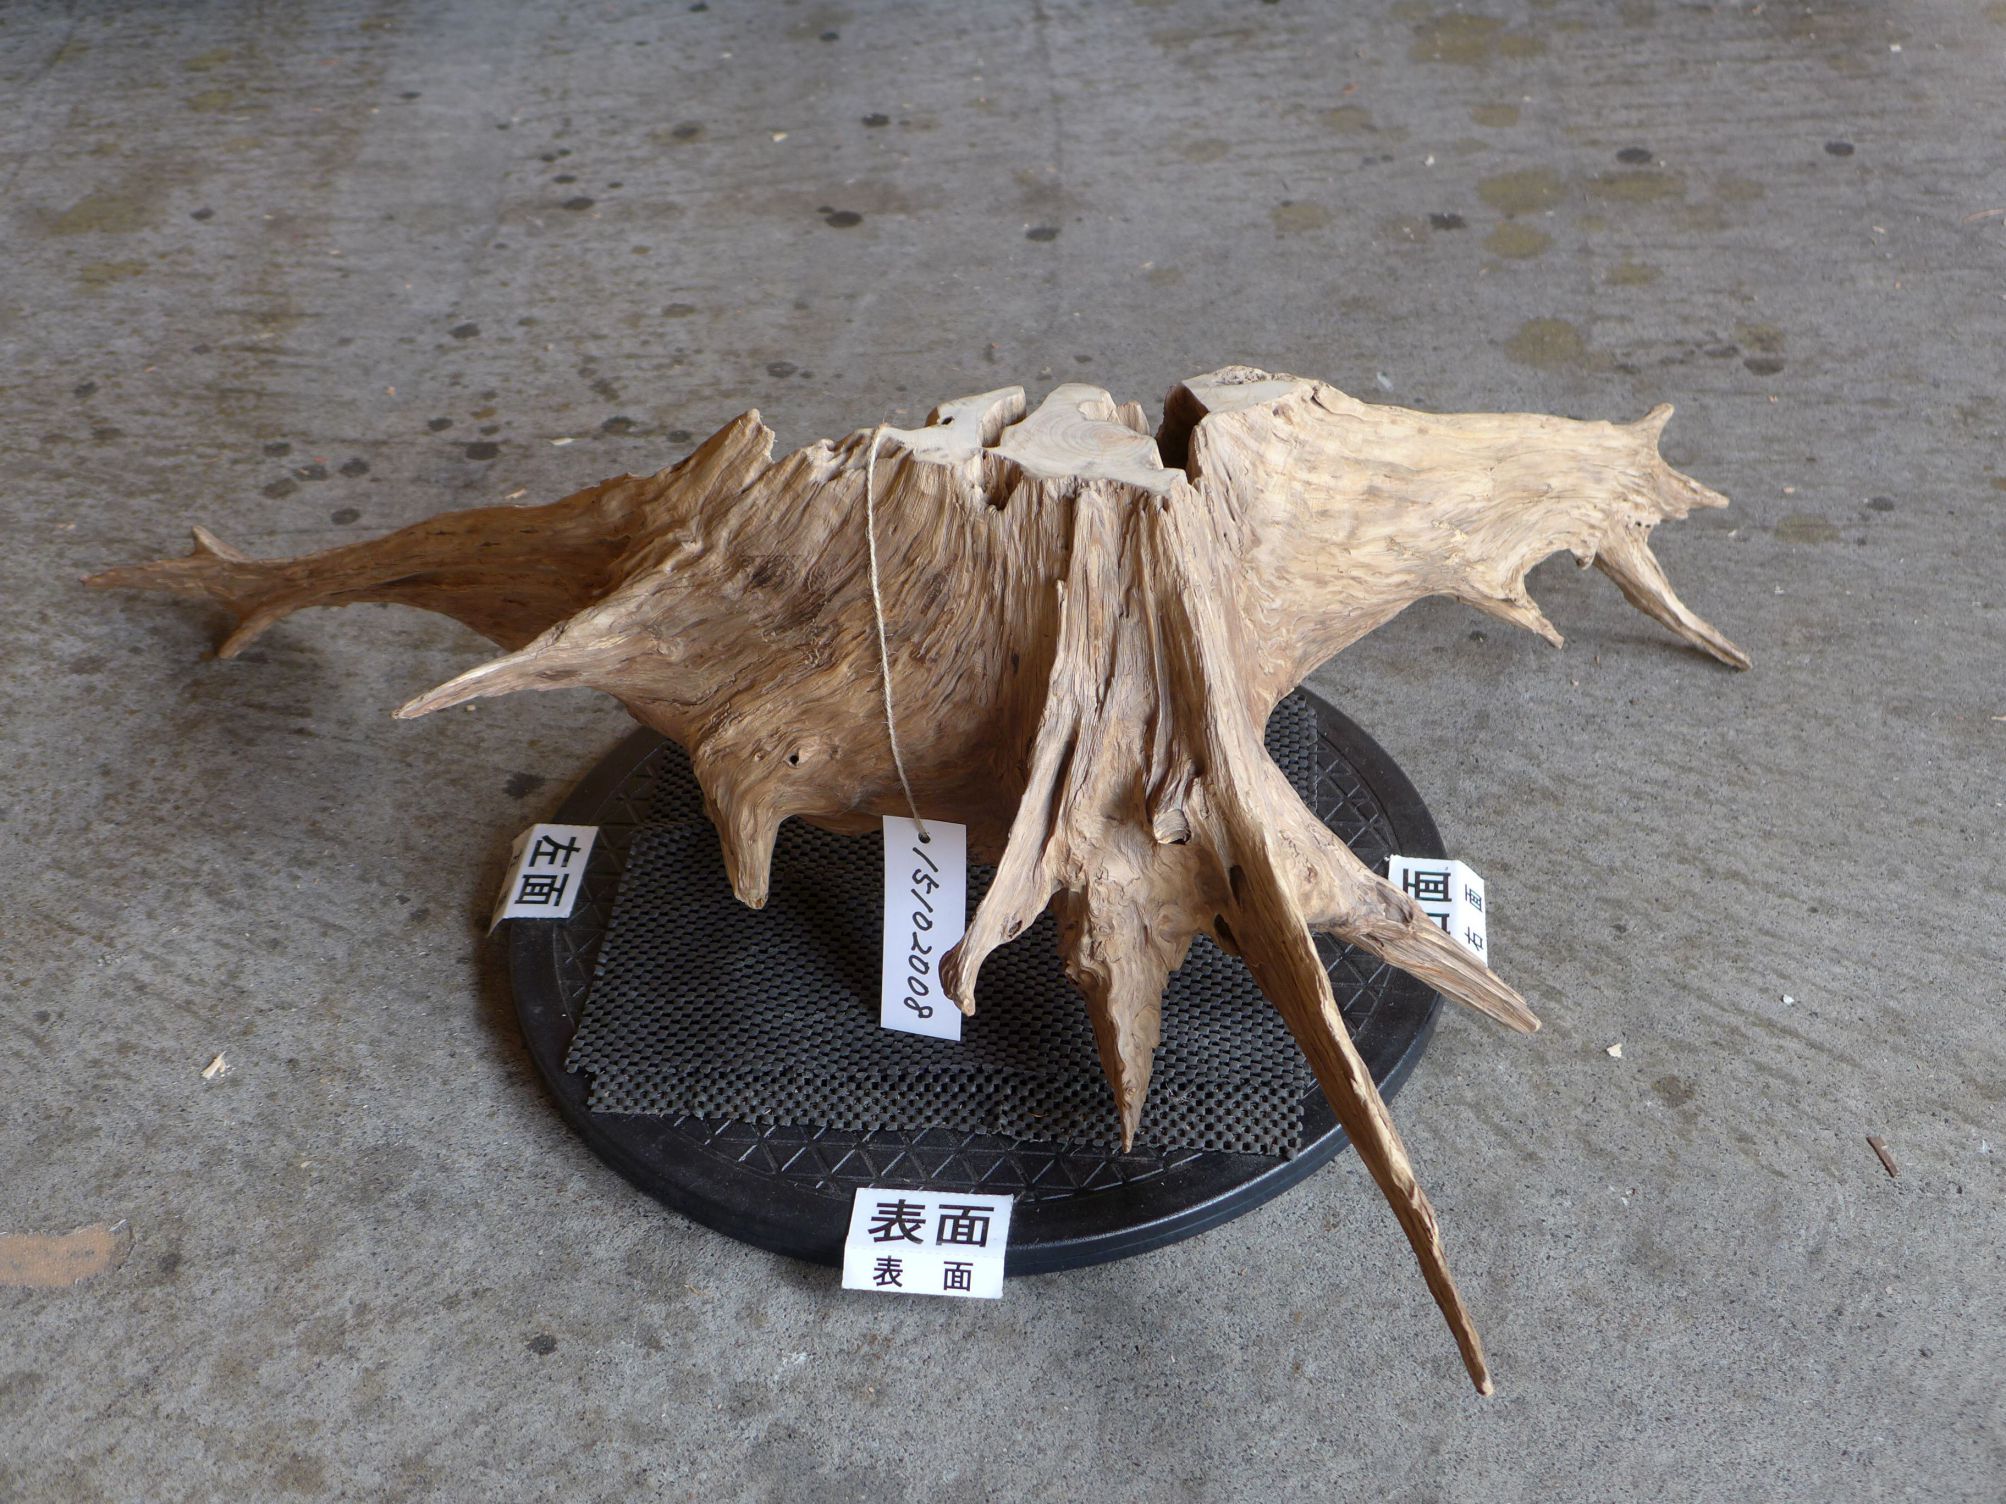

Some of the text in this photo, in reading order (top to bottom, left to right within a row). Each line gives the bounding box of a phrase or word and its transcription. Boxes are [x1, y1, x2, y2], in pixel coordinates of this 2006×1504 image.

[514, 835, 581, 907] 左面
[904, 847, 939, 1018] 15102008
[868, 1199, 995, 1247] 表面
